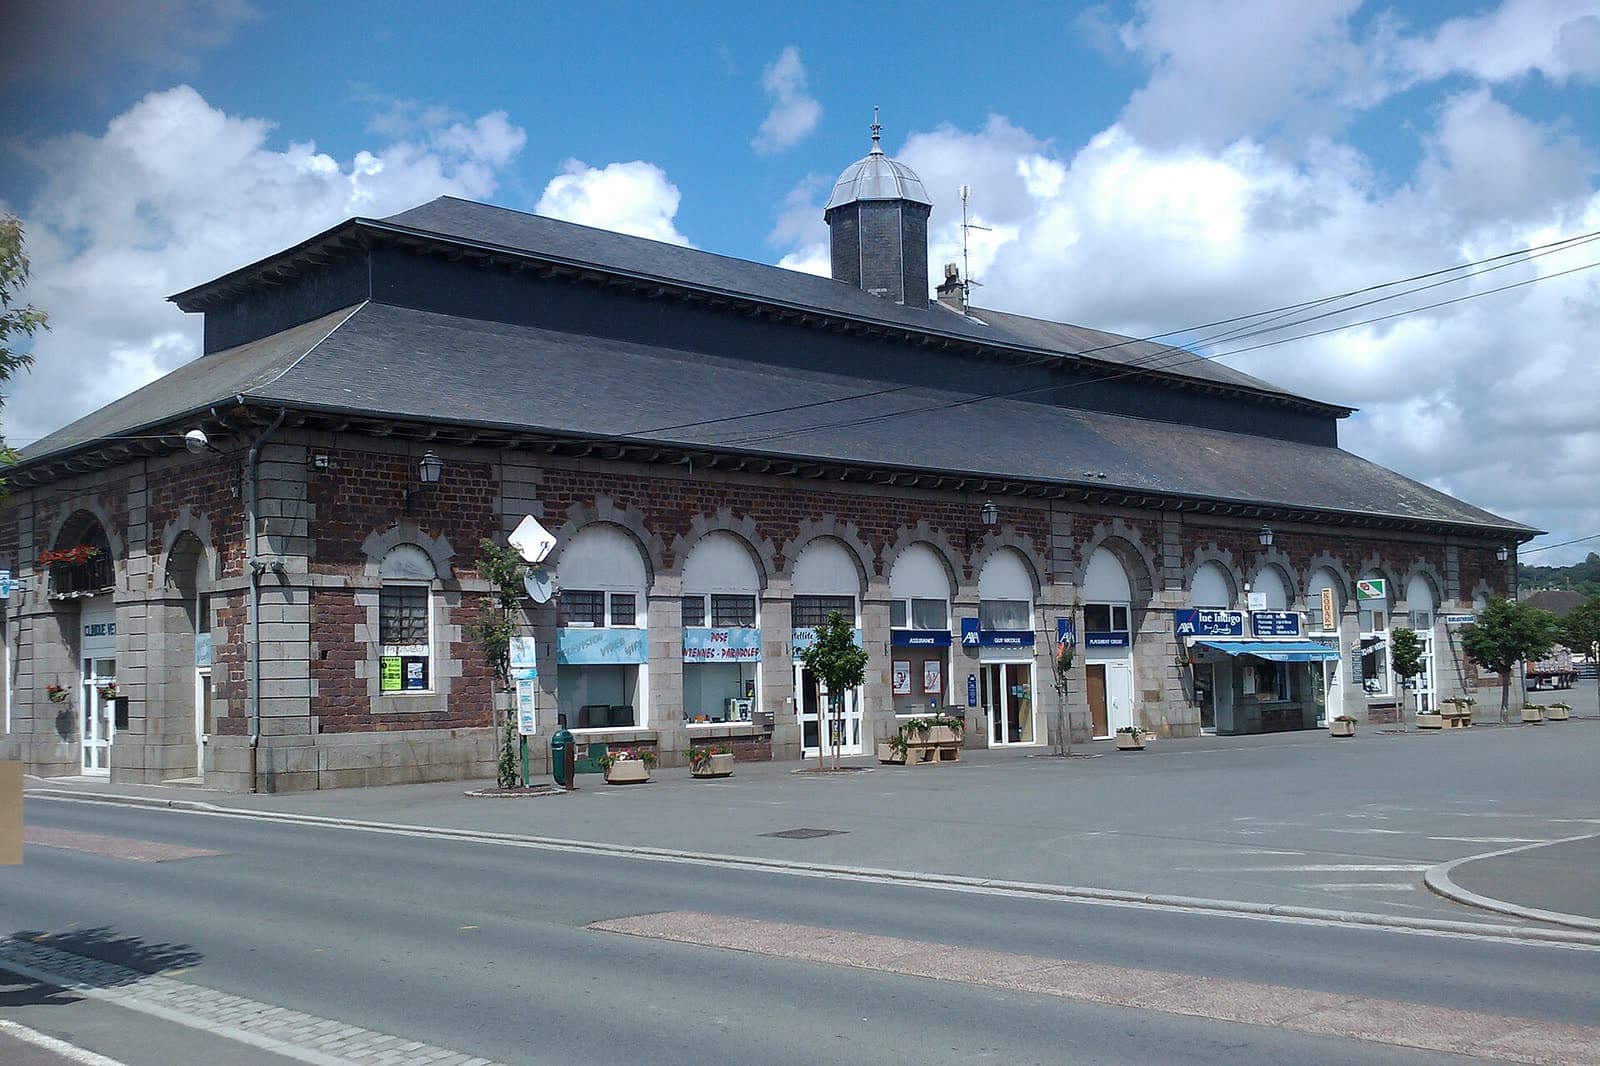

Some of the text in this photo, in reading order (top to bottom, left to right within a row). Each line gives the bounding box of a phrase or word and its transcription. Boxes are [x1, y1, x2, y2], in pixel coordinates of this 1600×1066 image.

[1323, 592, 1331, 624] KODAK
[1199, 612, 1240, 626] lue Indigo
[1177, 622, 1195, 633] AXA
[711, 632, 728, 642] POSE
[962, 632, 980, 643] AXA
[682, 647, 715, 658] NTENNES
